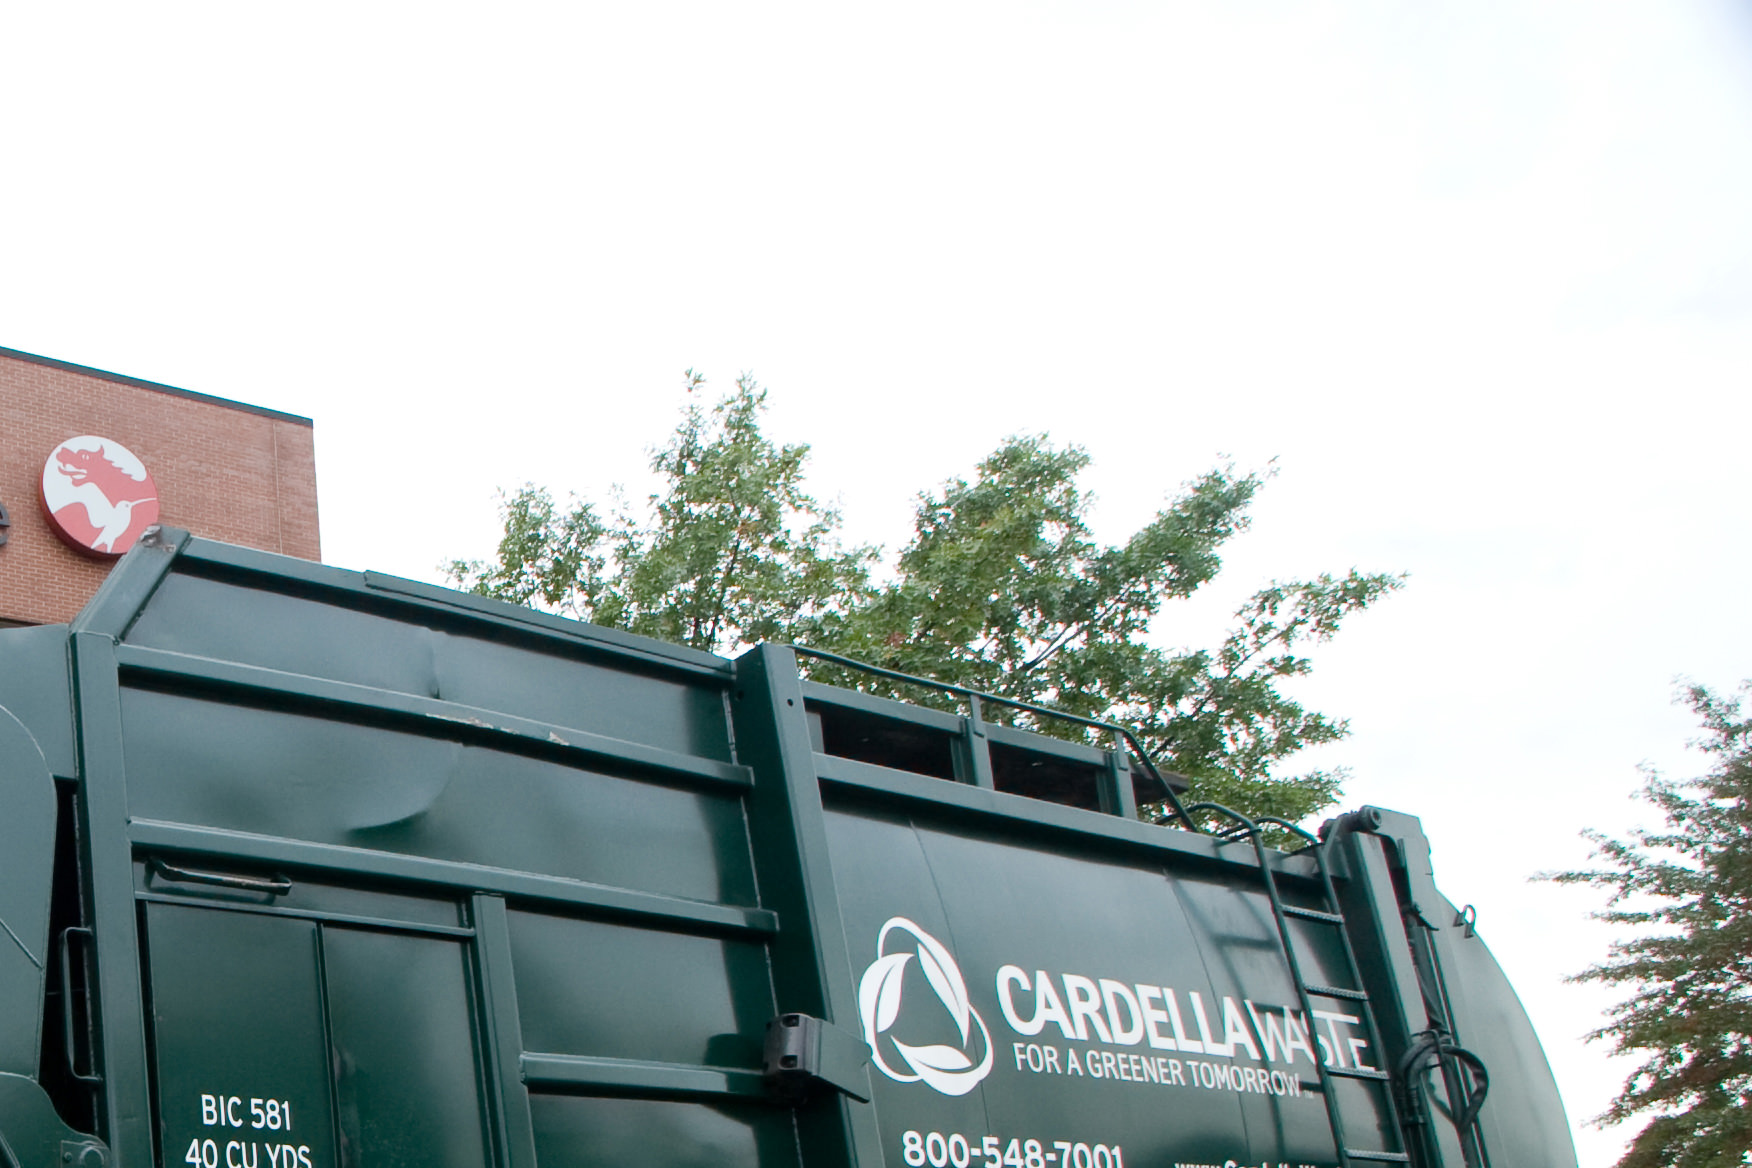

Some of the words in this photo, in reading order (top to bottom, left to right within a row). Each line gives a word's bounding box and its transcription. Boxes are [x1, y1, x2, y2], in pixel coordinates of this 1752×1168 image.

[1012, 1042, 1062, 1075] FOR
[1066, 1048, 1084, 1077] A
[1085, 1050, 1186, 1087] GREENER
[1186, 1060, 1300, 1098] TOMORROW
[201, 1094, 243, 1128] BIC
[250, 1097, 291, 1131] 581
